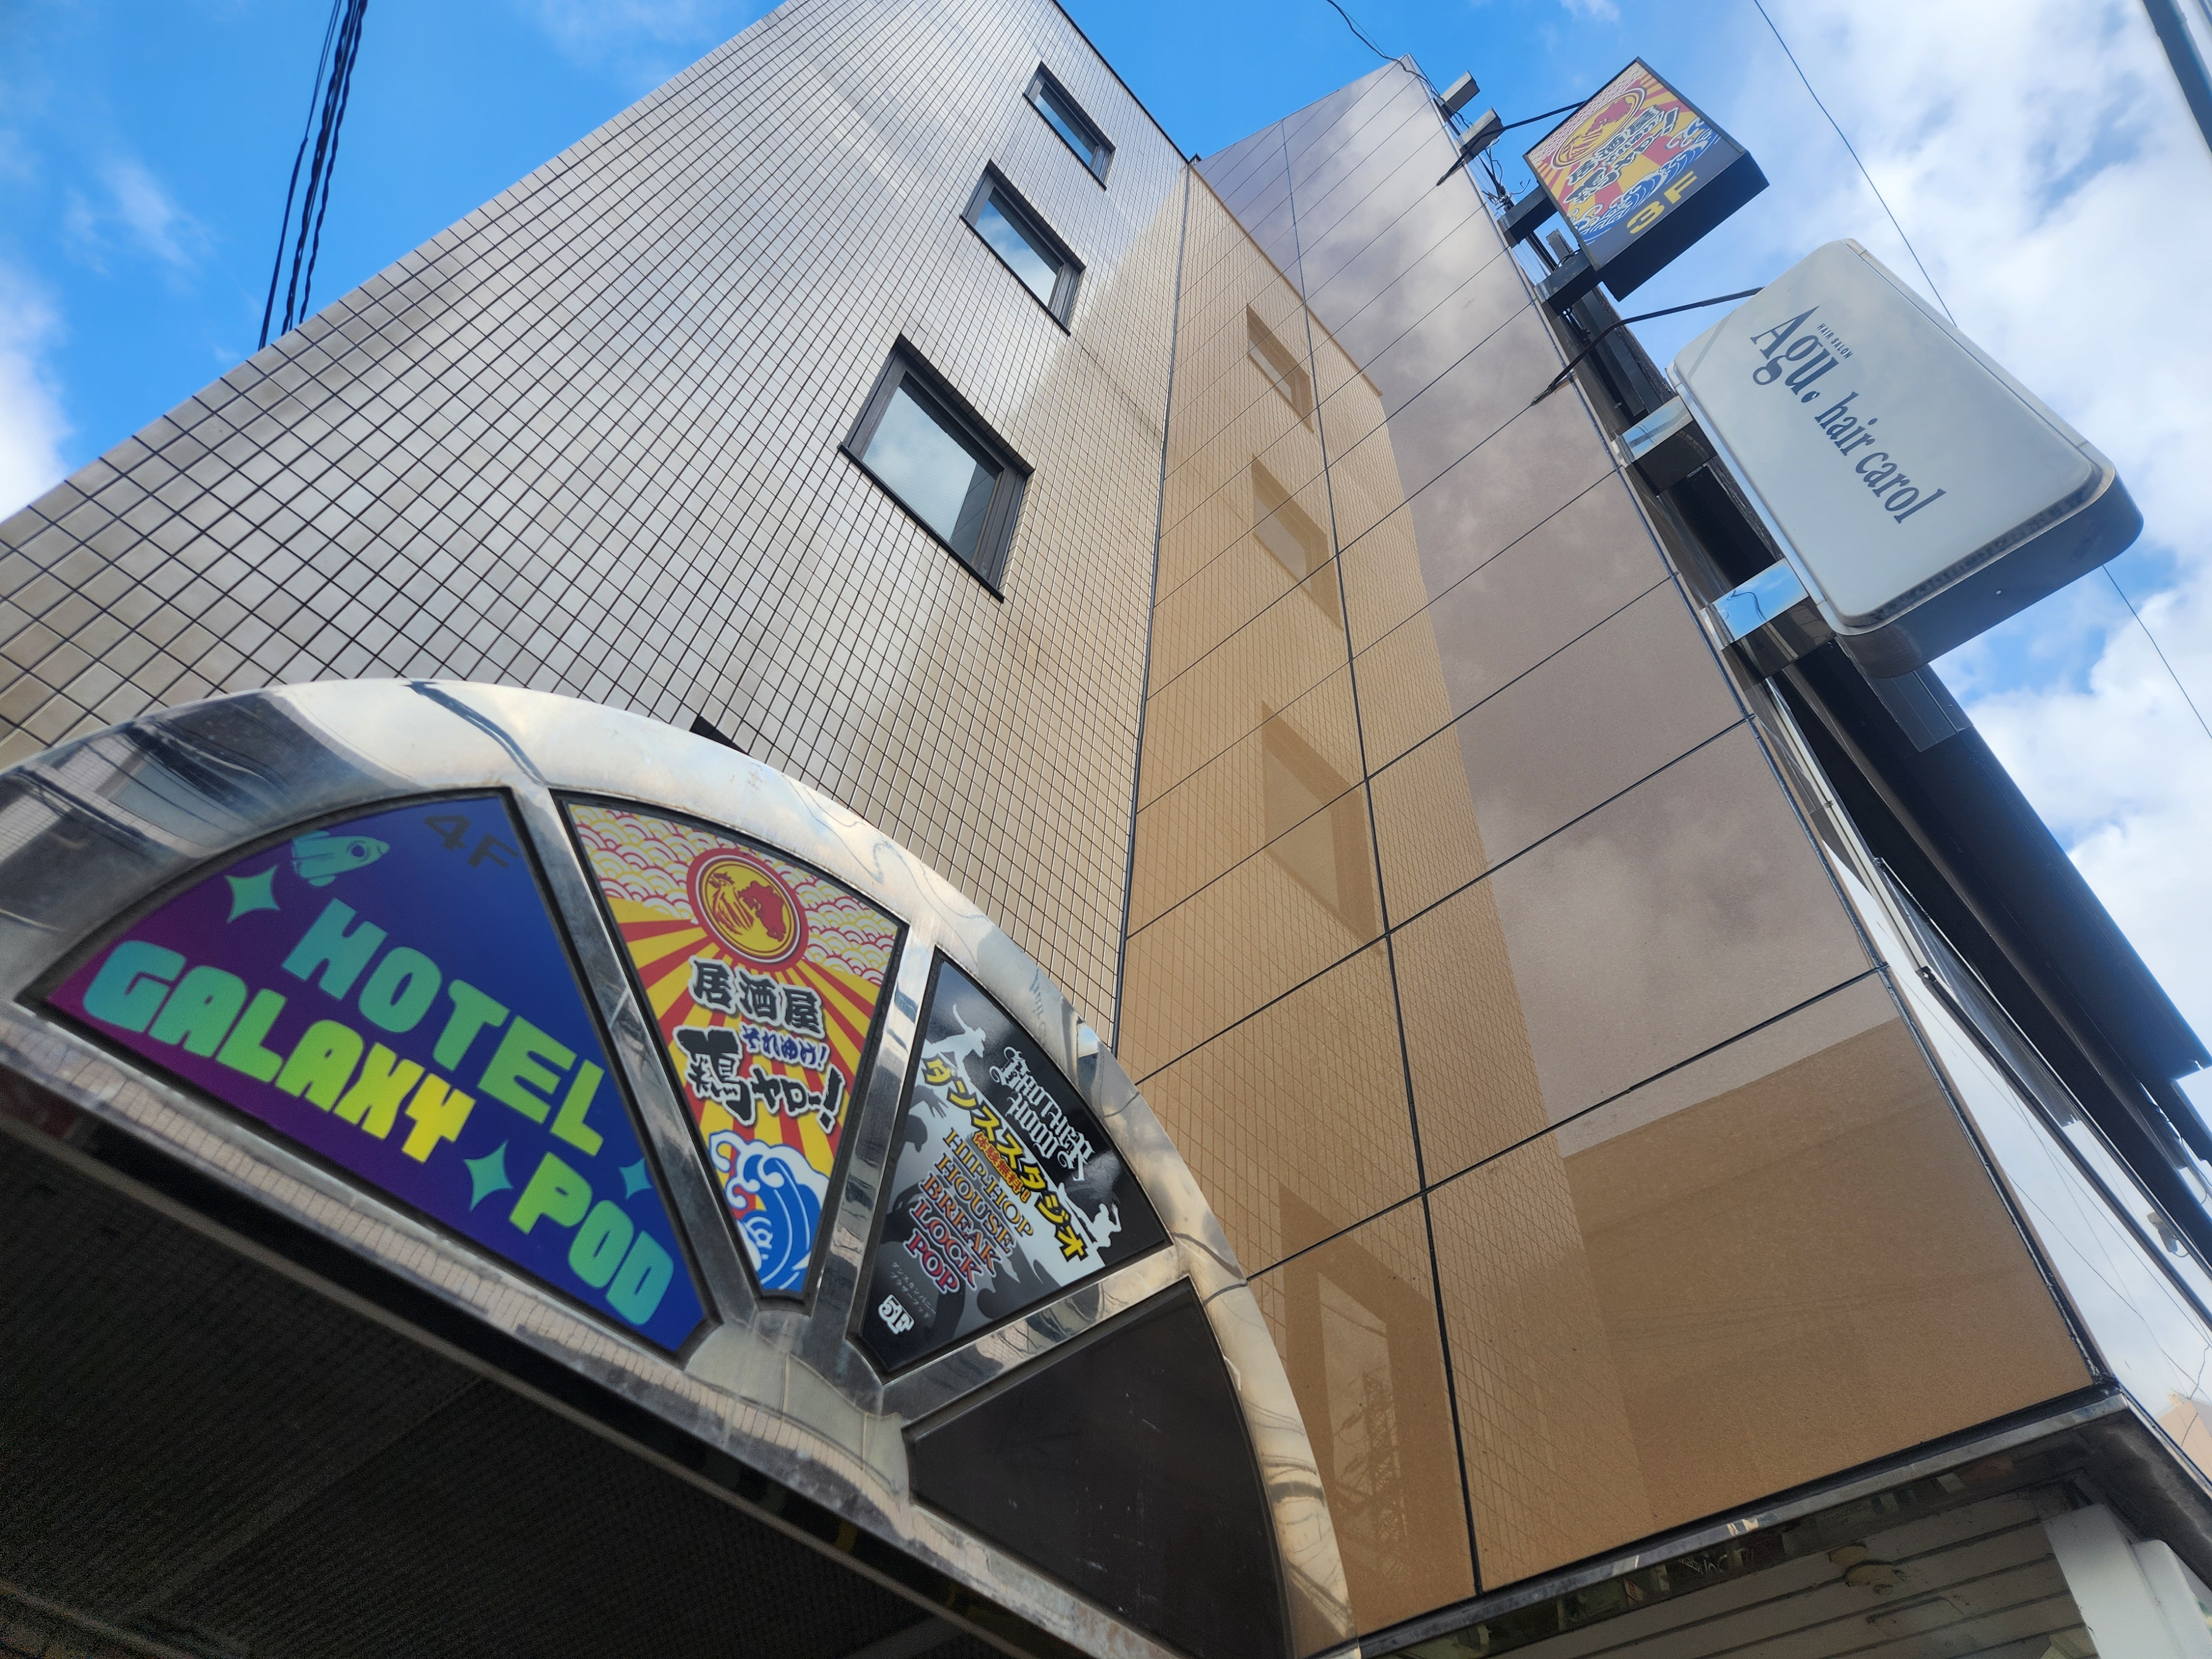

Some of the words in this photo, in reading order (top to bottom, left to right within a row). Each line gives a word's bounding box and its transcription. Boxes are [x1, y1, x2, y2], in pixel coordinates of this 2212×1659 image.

[1567, 106, 1661, 185] 居酒屋
[1626, 170, 1698, 234] 3F
[1817, 323, 1834, 339] HAIR
[1831, 338, 1853, 359] SALON
[1750, 305, 1839, 403] Agu.
[1814, 392, 1878, 456] hair
[1855, 451, 1947, 524] carol
[423, 813, 520, 870] 4F
[281, 897, 604, 1157] HOTEL
[691, 958, 823, 1036] 居酒屋
[83, 940, 477, 1164] GALAXY
[925, 1057, 1086, 1258] ダンススタジオ
[1005, 1091, 1060, 1159] HOOD
[934, 1153, 1015, 1254] HOUSE
[942, 1128, 1034, 1237] HIP-HOP
[974, 1133, 1031, 1202] 体験無料!
[509, 1151, 675, 1326] POD
[906, 1231, 959, 1293] POP
[911, 1199, 982, 1289] LOCK
[922, 1173, 1000, 1275] BREAK
[879, 1295, 914, 1334] 5F
